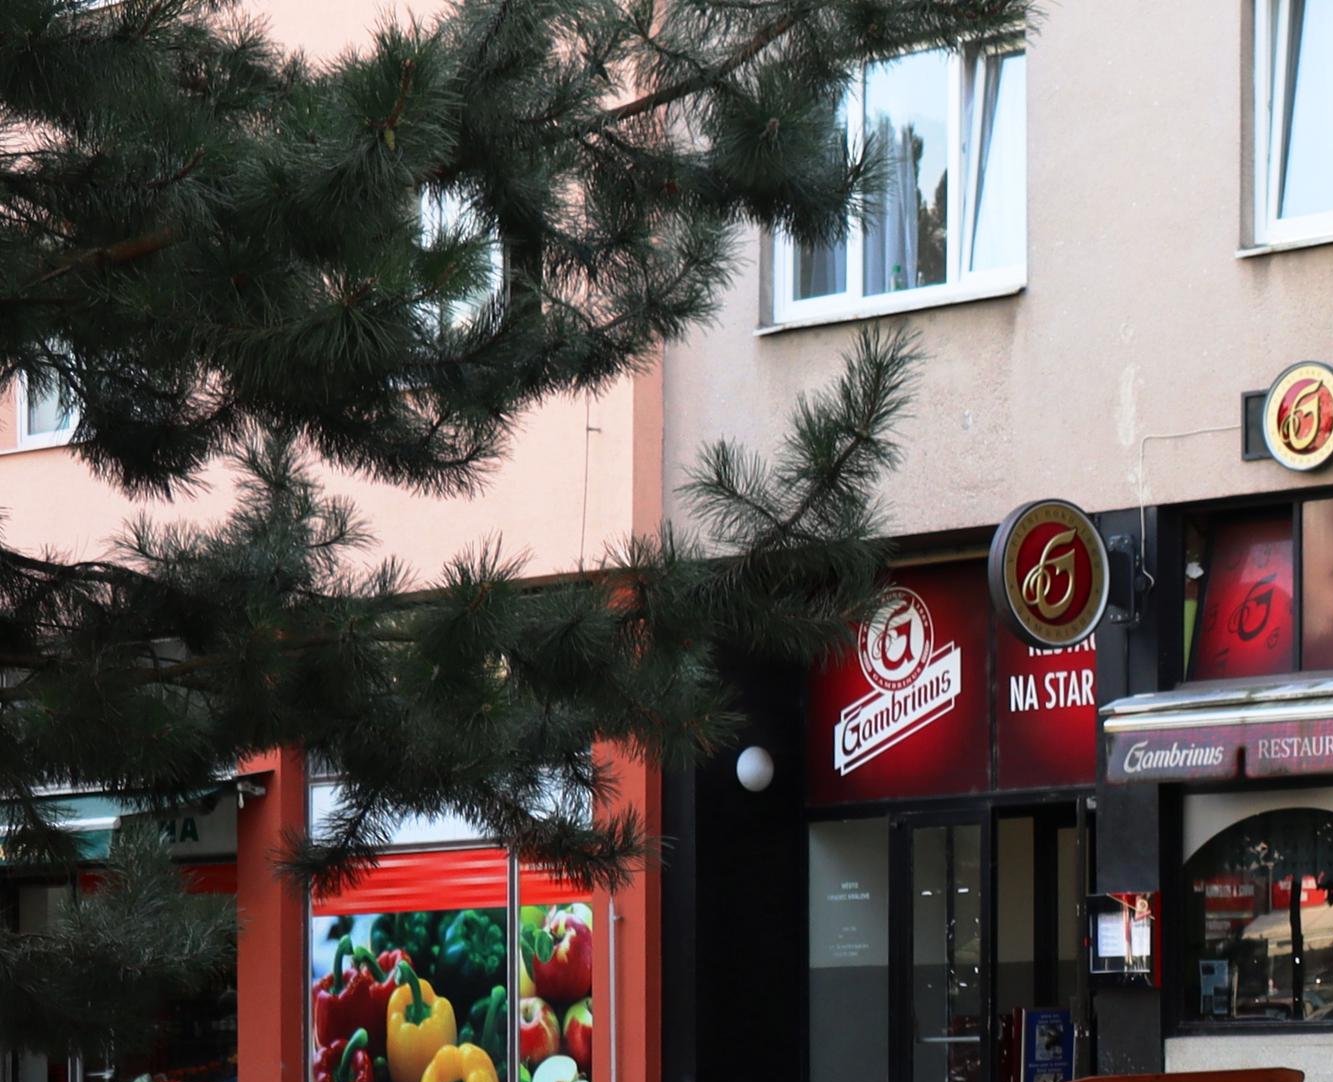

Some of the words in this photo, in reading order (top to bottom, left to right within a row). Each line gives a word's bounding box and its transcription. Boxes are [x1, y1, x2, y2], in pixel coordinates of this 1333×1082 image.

[1010, 674, 1040, 712] NA
[841, 670, 952, 757] Gambrinus
[1123, 741, 1224, 774] Gambrinus
